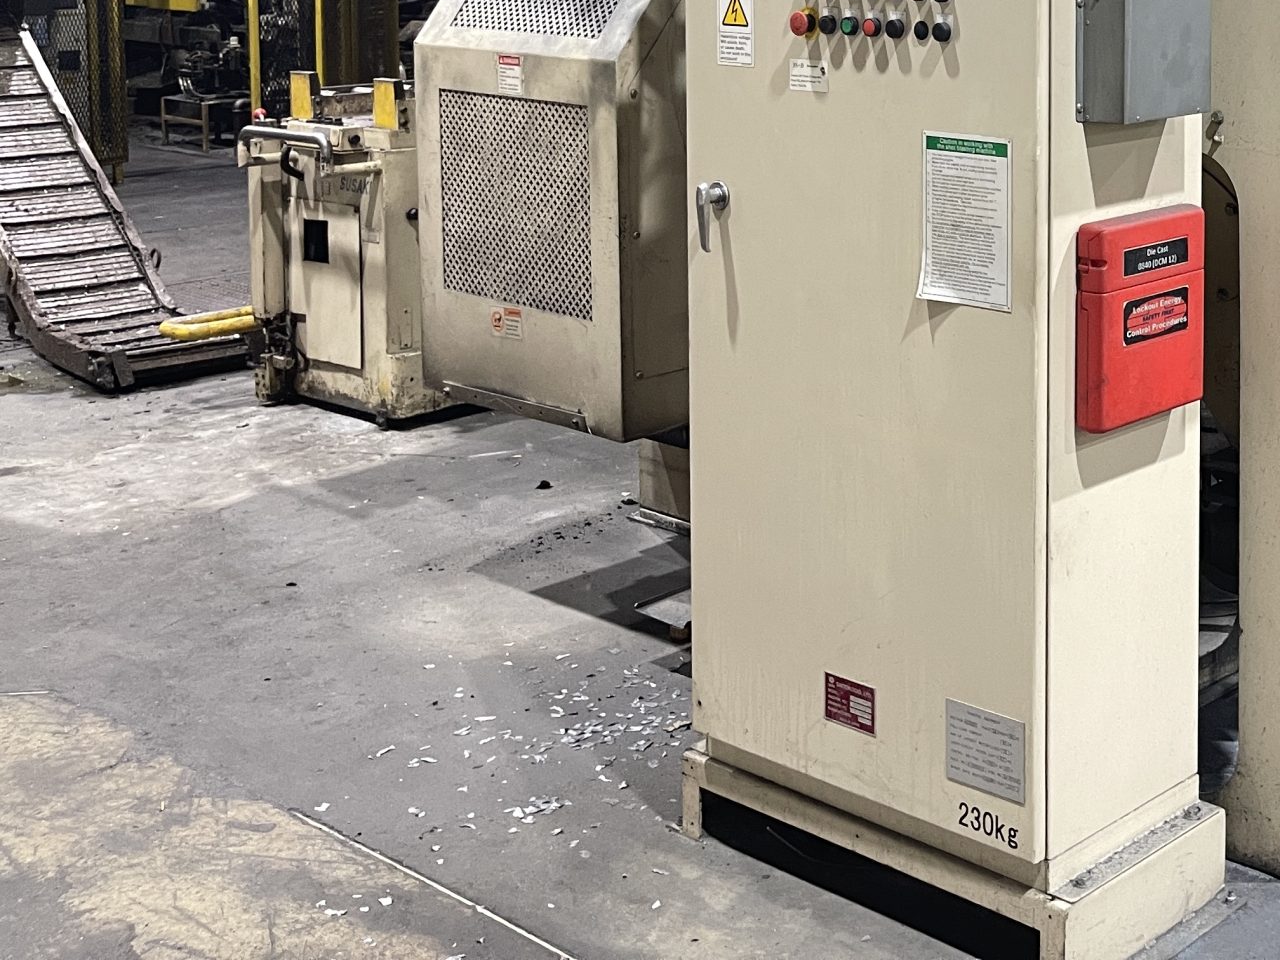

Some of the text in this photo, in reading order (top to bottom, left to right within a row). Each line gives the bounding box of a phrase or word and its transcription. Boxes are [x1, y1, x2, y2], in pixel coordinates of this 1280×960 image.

[1146, 245, 1169, 256] Die Cast
[1132, 296, 1182, 314] Lockout Energy
[1126, 315, 1187, 338] Control Procedures
[958, 802, 1019, 850] 230kg
